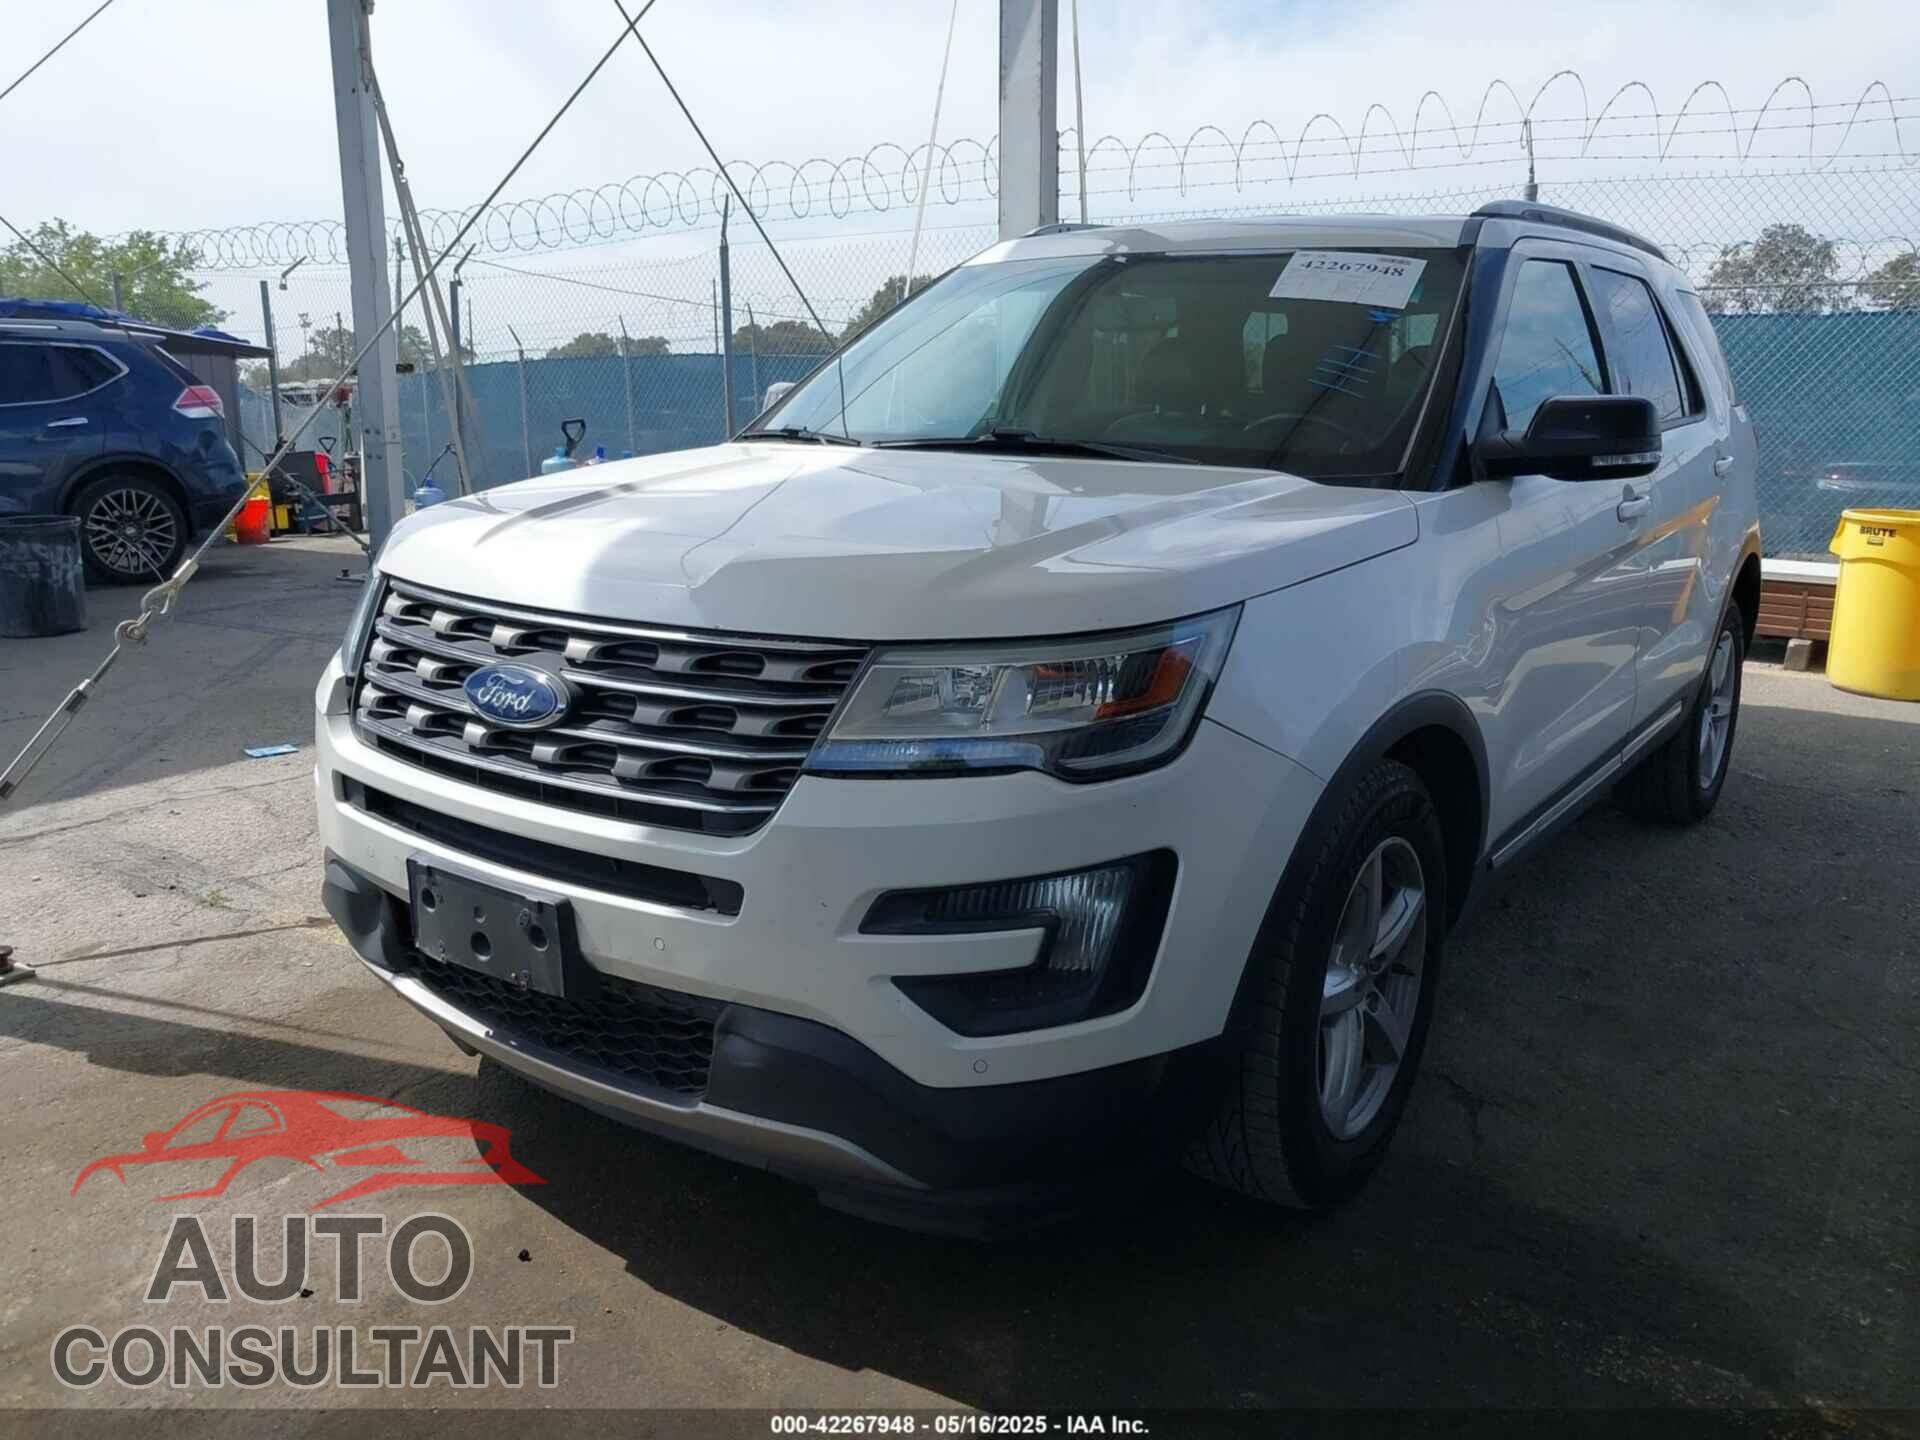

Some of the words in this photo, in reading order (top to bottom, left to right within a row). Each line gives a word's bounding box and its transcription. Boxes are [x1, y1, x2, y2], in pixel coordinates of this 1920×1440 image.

[1301, 260, 1406, 277] 42267948
[1860, 526, 1897, 537] BRUTE
[478, 673, 537, 713] Ford
